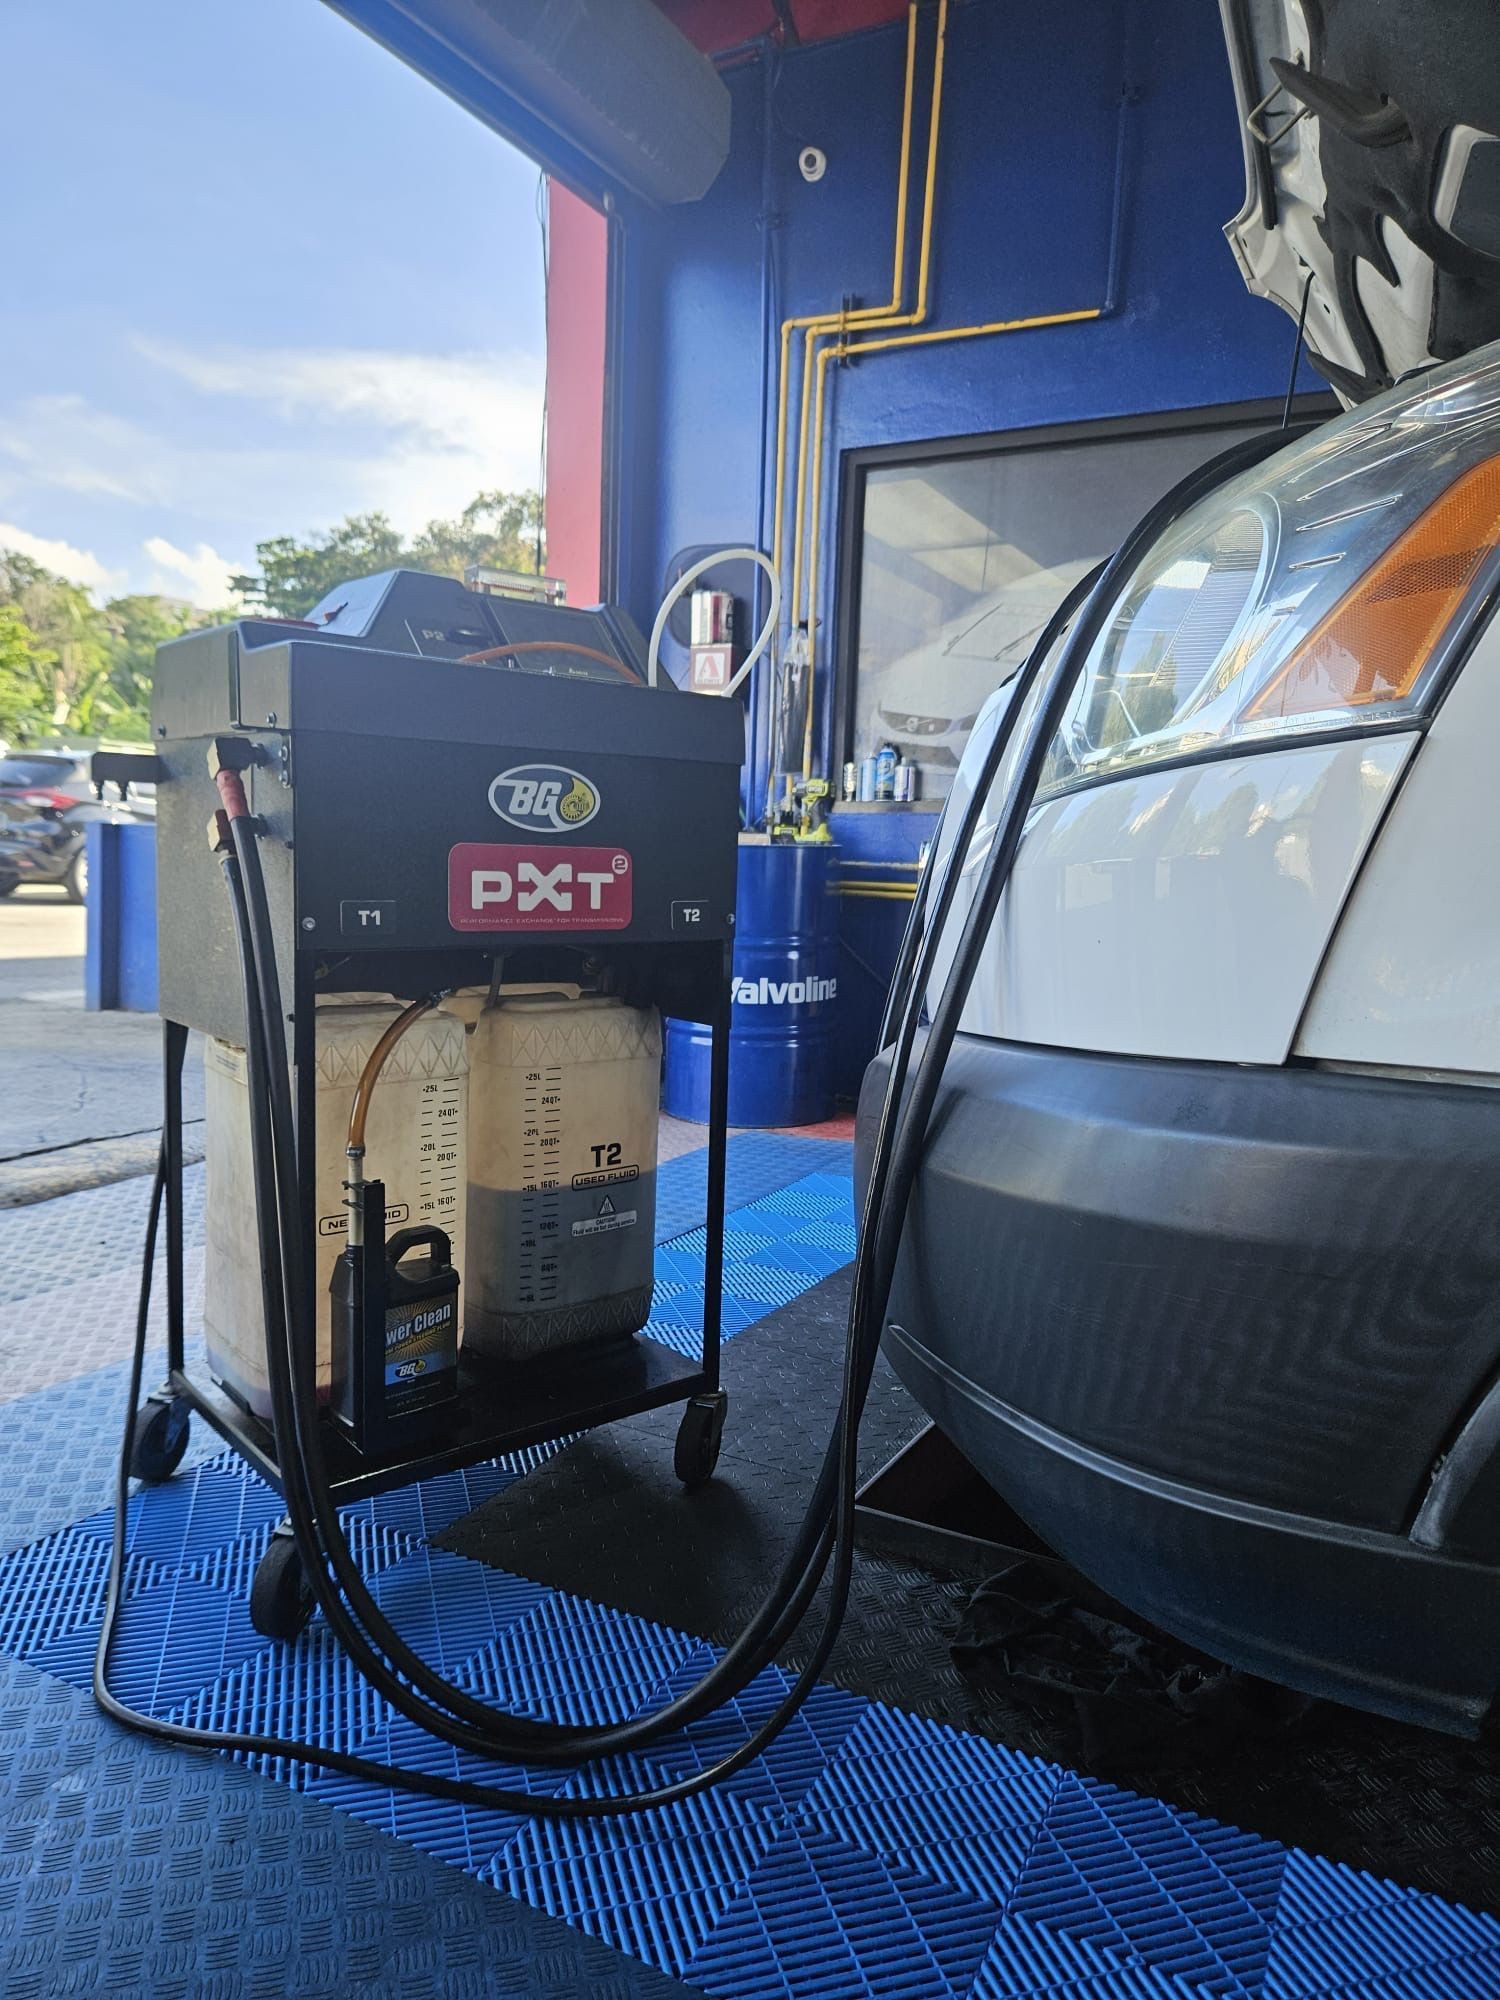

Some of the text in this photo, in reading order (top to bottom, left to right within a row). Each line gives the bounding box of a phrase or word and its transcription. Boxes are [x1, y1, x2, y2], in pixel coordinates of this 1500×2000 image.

[501, 779, 562, 816] BG
[358, 910, 381, 926] T1
[683, 908, 700, 922] T2
[590, 1142, 622, 1168] T2
[575, 1169, 636, 1186] USED FLUID
[328, 1219, 348, 1230] NE
[386, 1303, 451, 1347] wer Clean
[397, 1362, 417, 1377] BG
